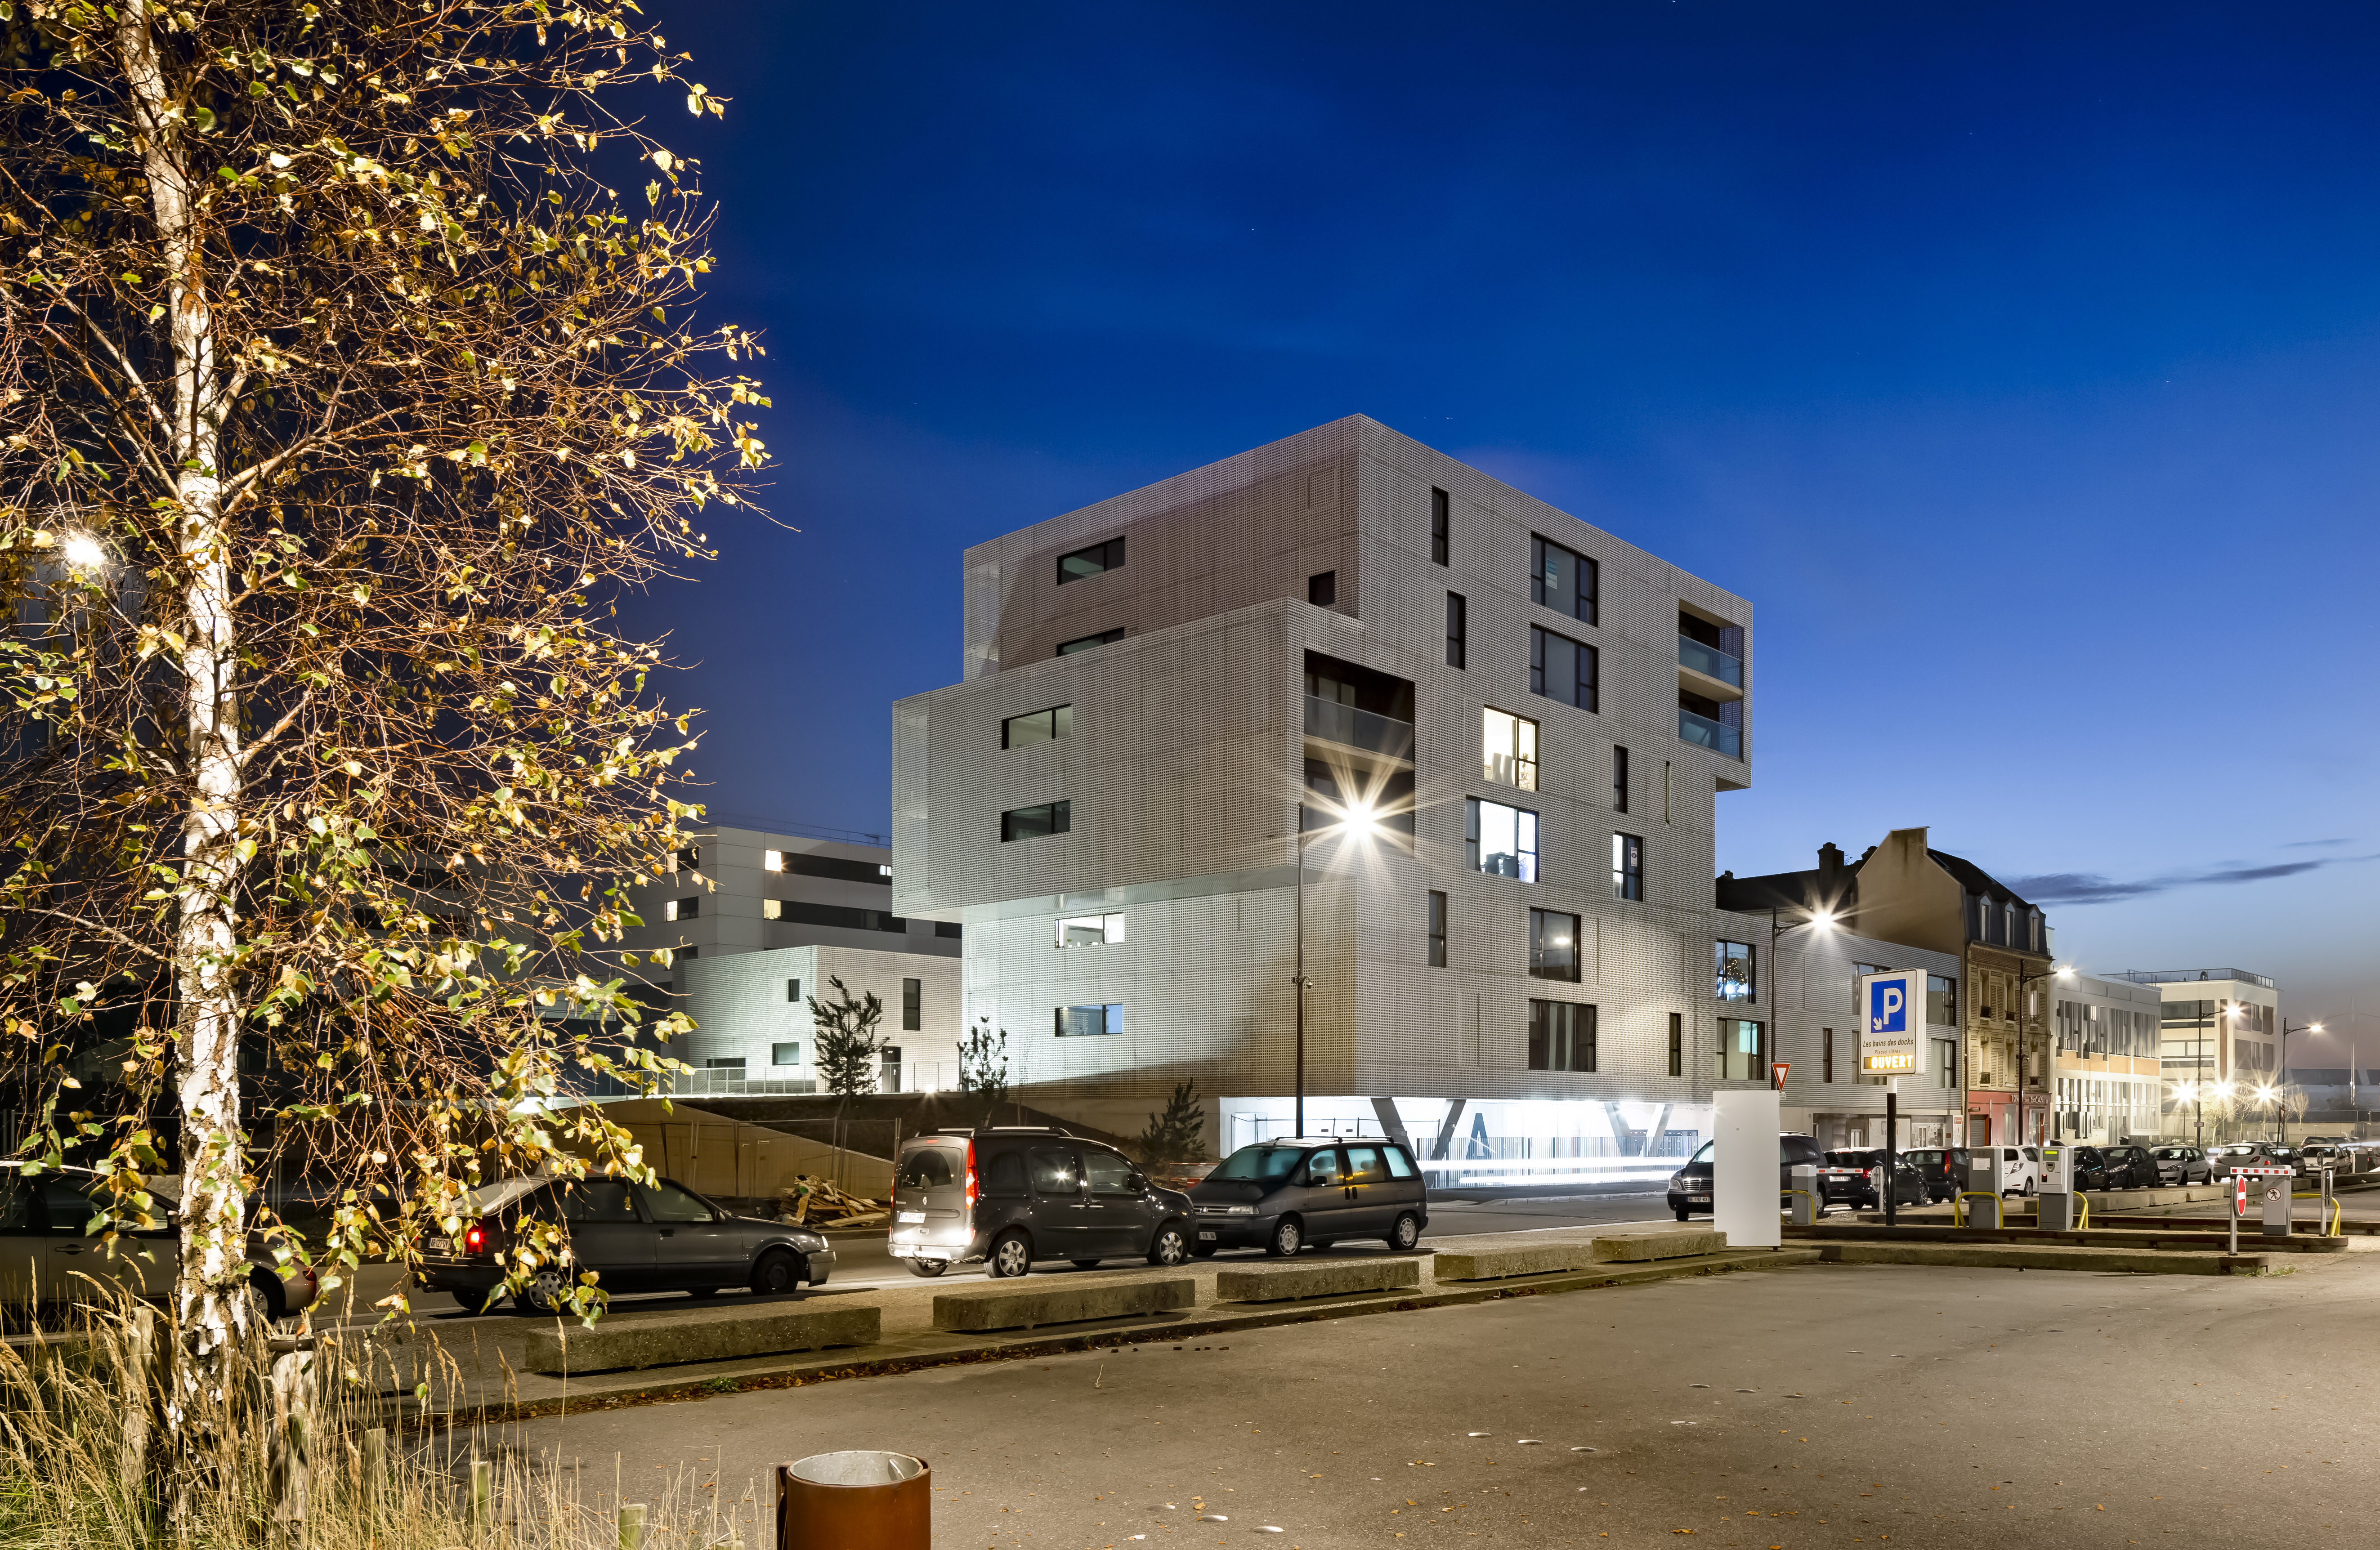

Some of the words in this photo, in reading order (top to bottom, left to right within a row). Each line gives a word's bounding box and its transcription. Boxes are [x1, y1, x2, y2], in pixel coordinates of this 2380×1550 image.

[1883, 987, 1903, 1025] P
[1897, 1037, 1914, 1045] docks
[1871, 1055, 1913, 1069] OUVERT
